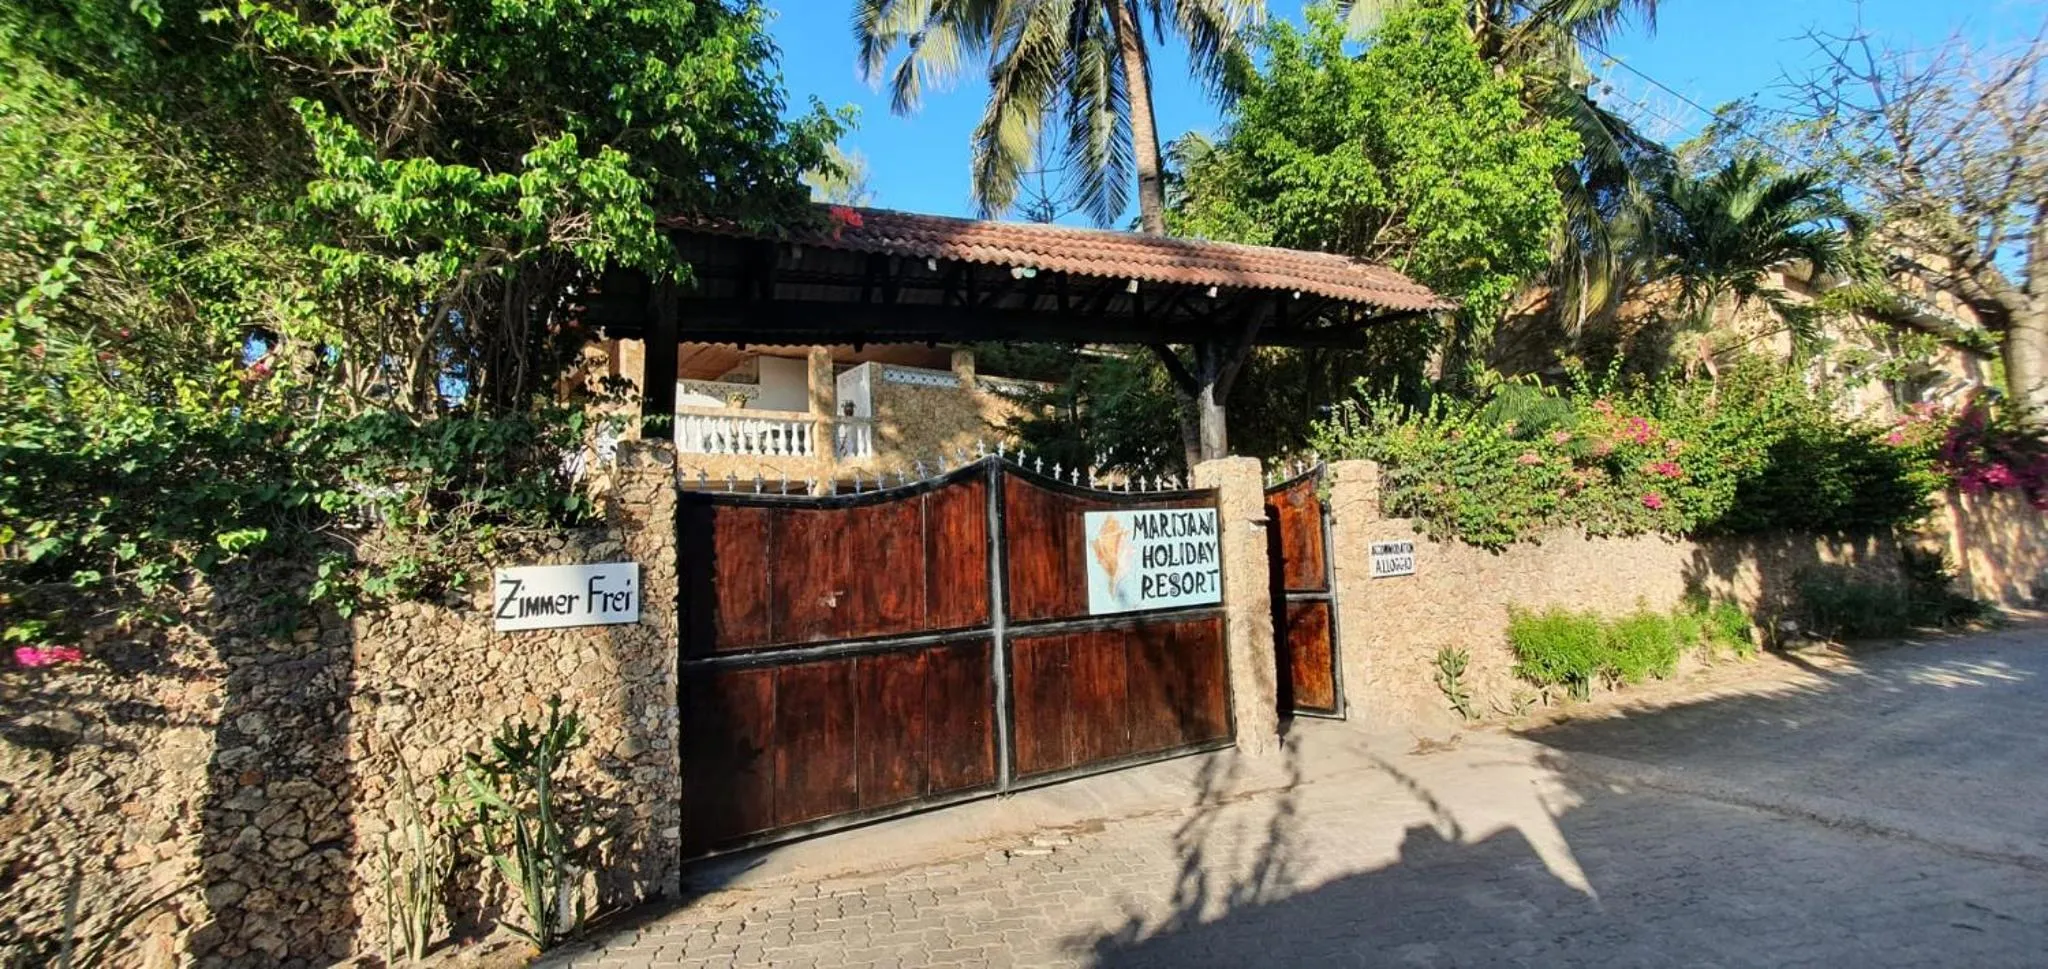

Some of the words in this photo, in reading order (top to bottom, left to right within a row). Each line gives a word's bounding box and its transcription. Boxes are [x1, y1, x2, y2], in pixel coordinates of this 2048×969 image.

[1142, 541, 1217, 569] HOLIDAY
[496, 579, 580, 619] Zimmer
[587, 575, 632, 613] Frei
[1141, 569, 1219, 600] RESORT
